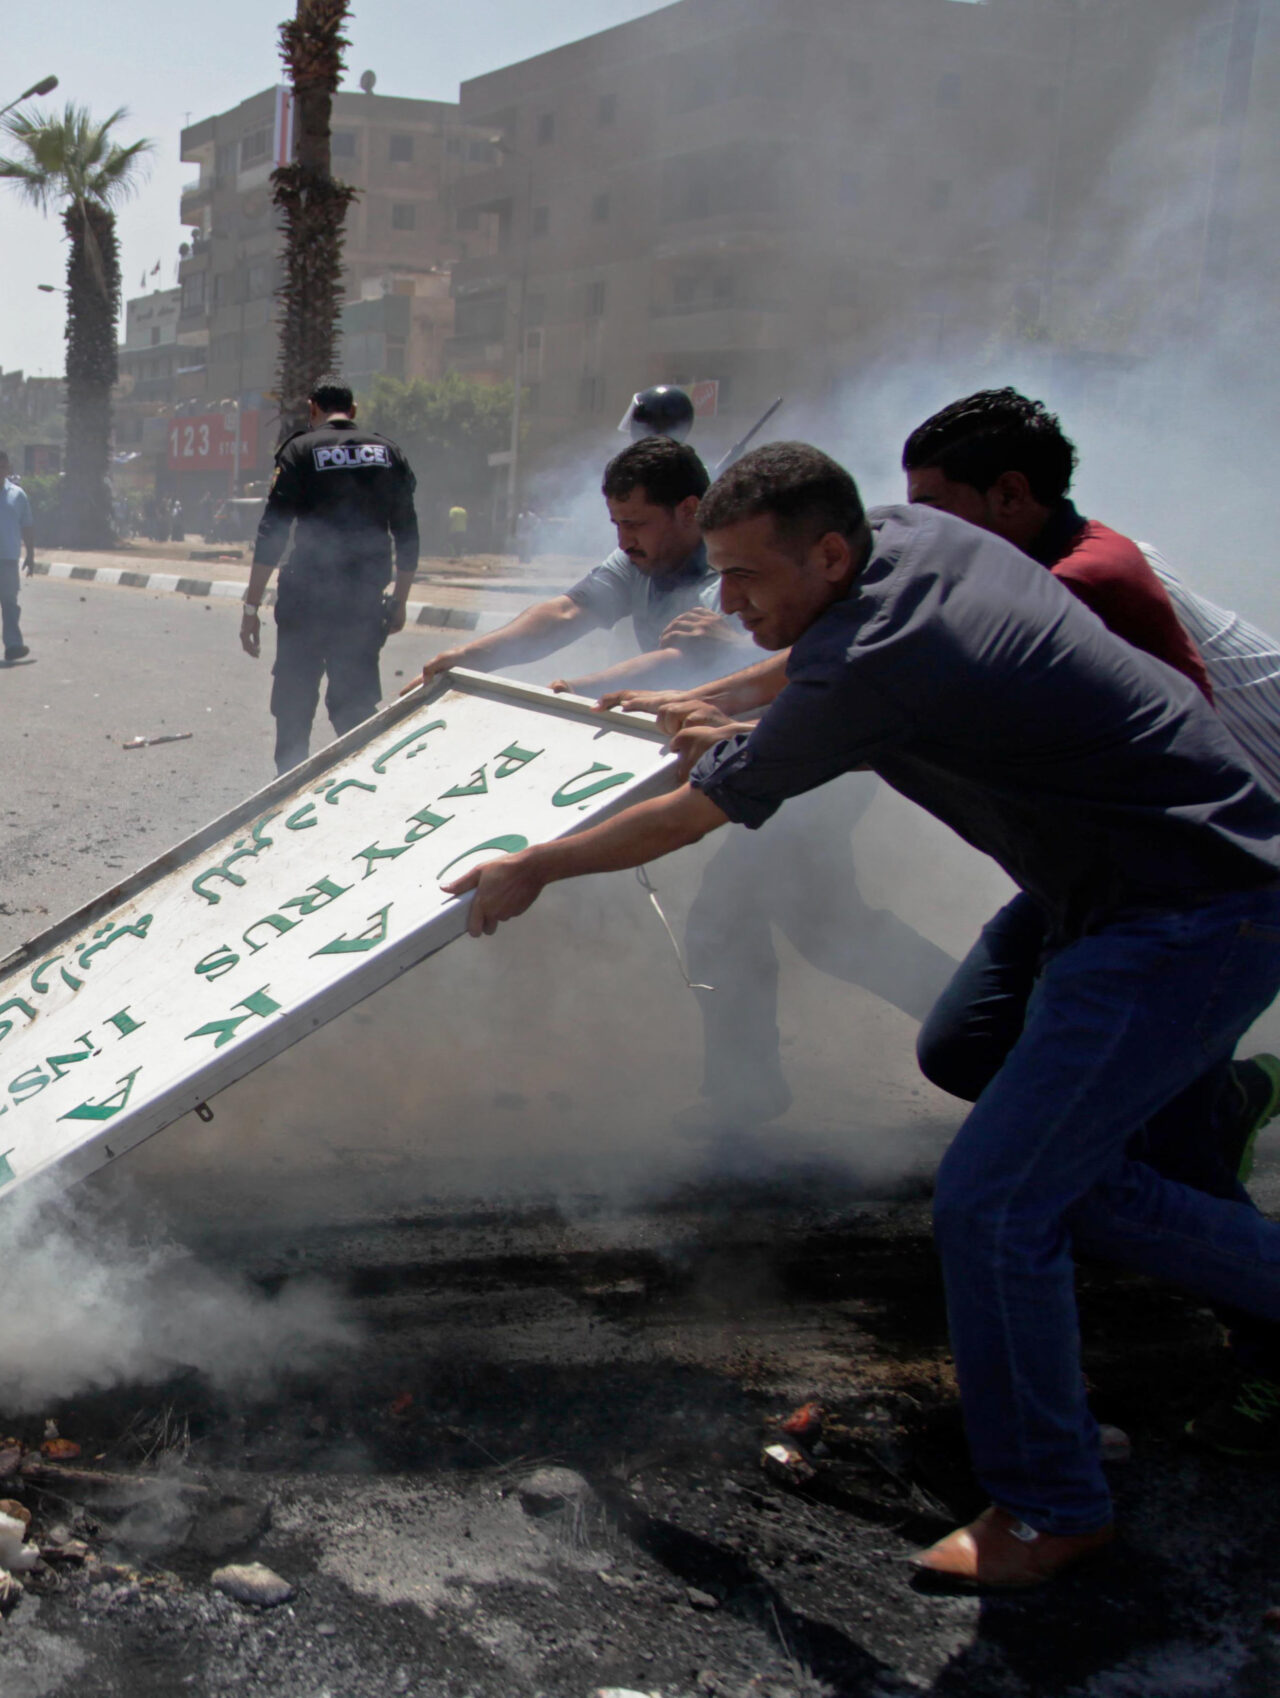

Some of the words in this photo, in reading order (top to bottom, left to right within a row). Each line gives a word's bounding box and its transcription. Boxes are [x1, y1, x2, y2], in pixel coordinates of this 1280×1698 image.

[170, 423, 210, 457] 123
[219, 440, 249, 456] STOK
[318, 446, 386, 467] POLICE
[191, 718, 448, 905] للبرديات
[193, 739, 546, 983] PAPYRUS
